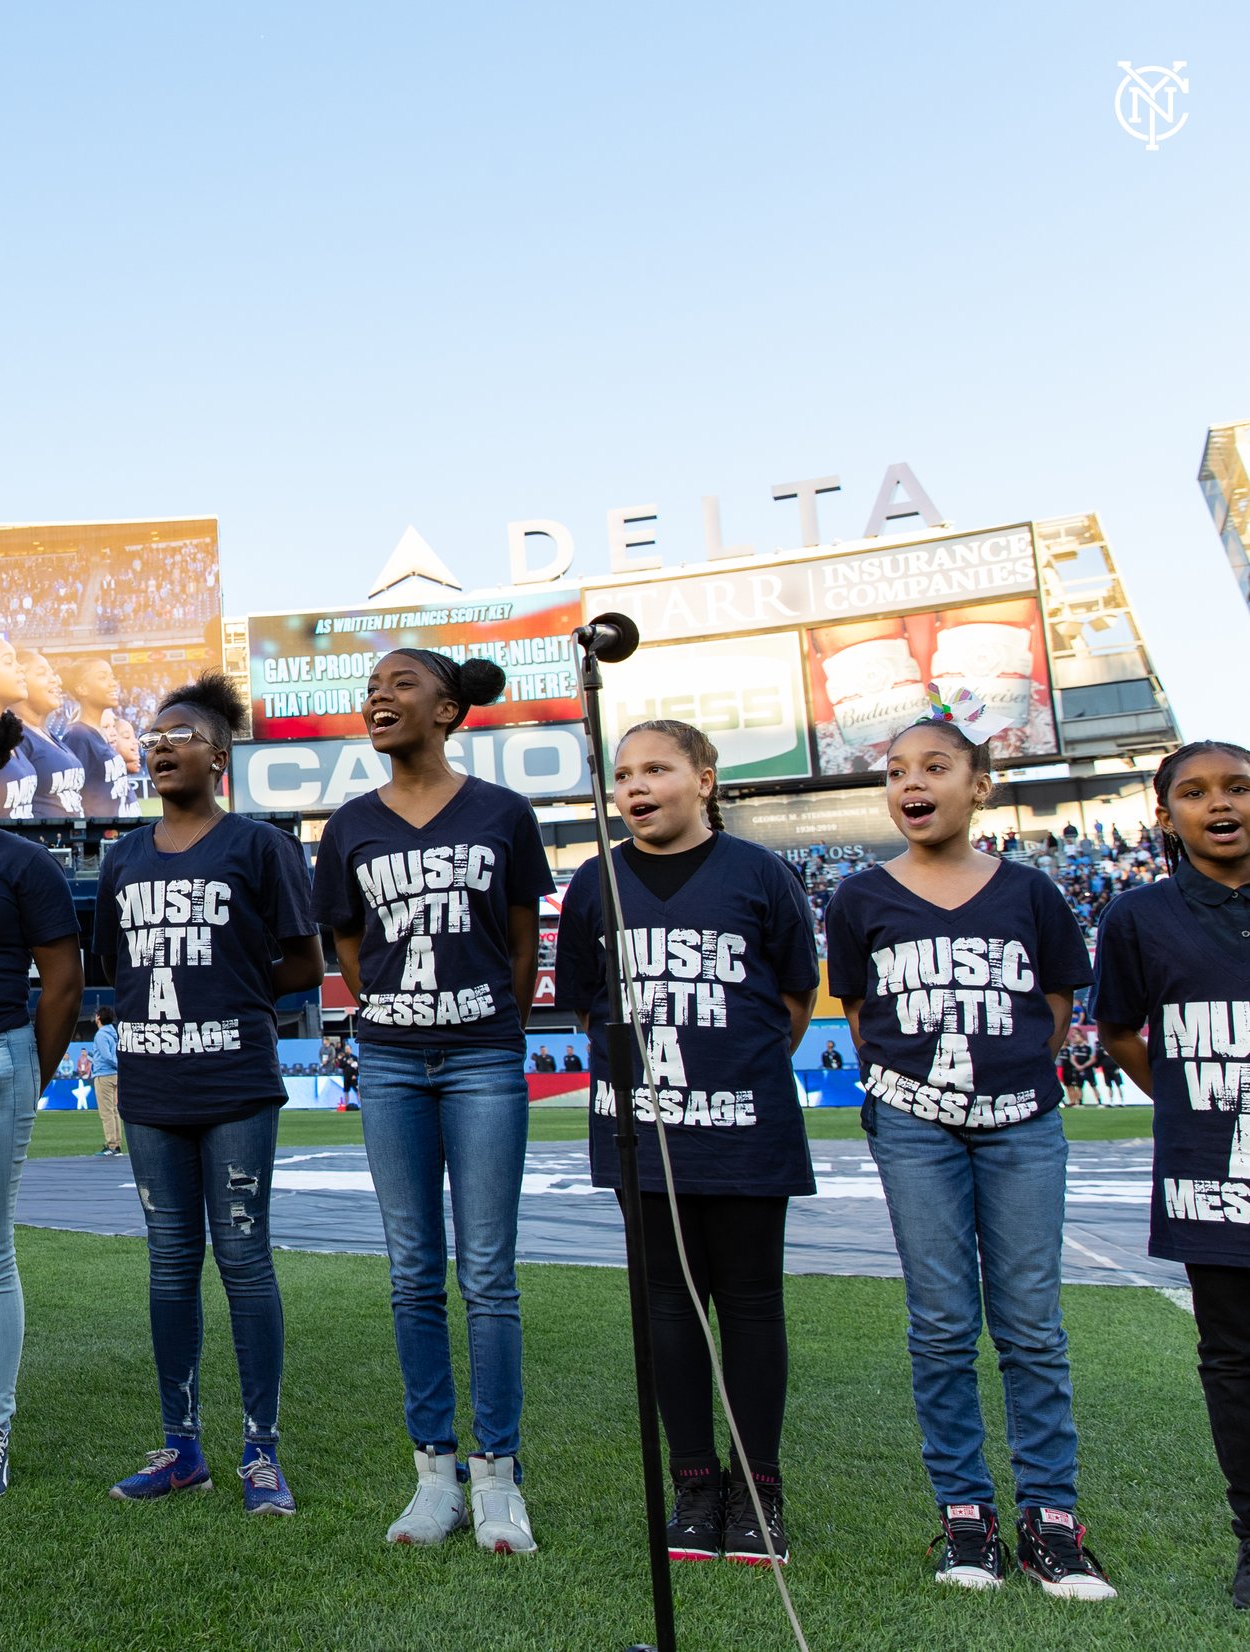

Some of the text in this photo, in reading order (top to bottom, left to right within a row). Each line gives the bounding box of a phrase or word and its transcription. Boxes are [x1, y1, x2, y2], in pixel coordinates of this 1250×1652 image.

[507, 462, 945, 586] DELTA
[822, 531, 1033, 587] INSURANCE
[824, 558, 1037, 611] COMPANIES
[315, 603, 512, 635] AS WRITTEN BY FRANCIS SCOTT KEY
[264, 656, 311, 683] GAVE
[314, 652, 374, 680] PROOF
[509, 635, 572, 667] NIGHT
[262, 691, 309, 718] THAT
[314, 688, 352, 715] OUR
[509, 671, 578, 702] THERE;
[616, 686, 783, 738] HESS
[752, 814, 787, 824] GEORGE
[356, 843, 496, 909] MUSIC
[116, 878, 232, 929] MUSIC
[378, 890, 471, 943] WITH
[125, 926, 212, 968] WITH
[400, 935, 438, 991] A
[871, 936, 1035, 996] MUSIC
[148, 967, 181, 1021] A
[359, 983, 496, 1027] MESSAGE
[620, 981, 727, 1028] WITH
[896, 989, 1013, 1036] WITH
[117, 1018, 241, 1055] MESSAGE
[642, 1026, 688, 1087] A
[927, 1033, 975, 1093] A
[864, 1063, 1039, 1128] MESSAGE
